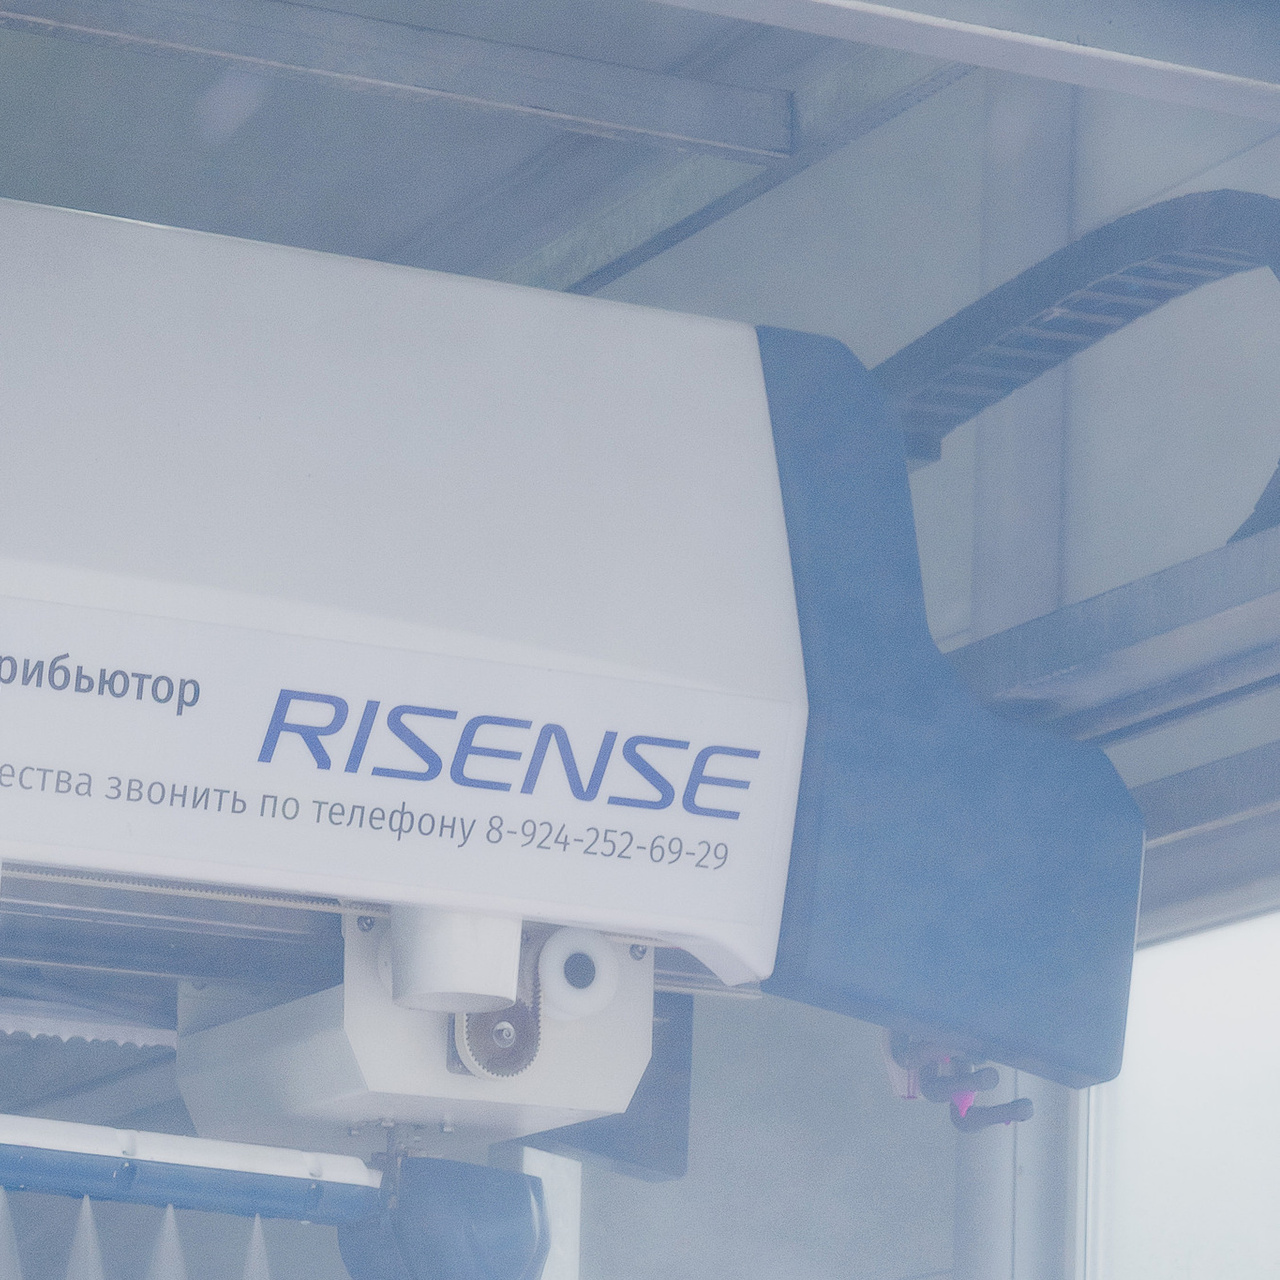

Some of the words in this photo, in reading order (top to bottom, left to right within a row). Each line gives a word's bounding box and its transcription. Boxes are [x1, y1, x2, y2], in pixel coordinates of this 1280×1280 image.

[256, 687, 762, 822] RISENSE
[105, 775, 248, 816] звонить
[259, 793, 301, 822] по
[311, 799, 478, 849] телефону
[484, 814, 730, 872] 8-924-252-69-29
